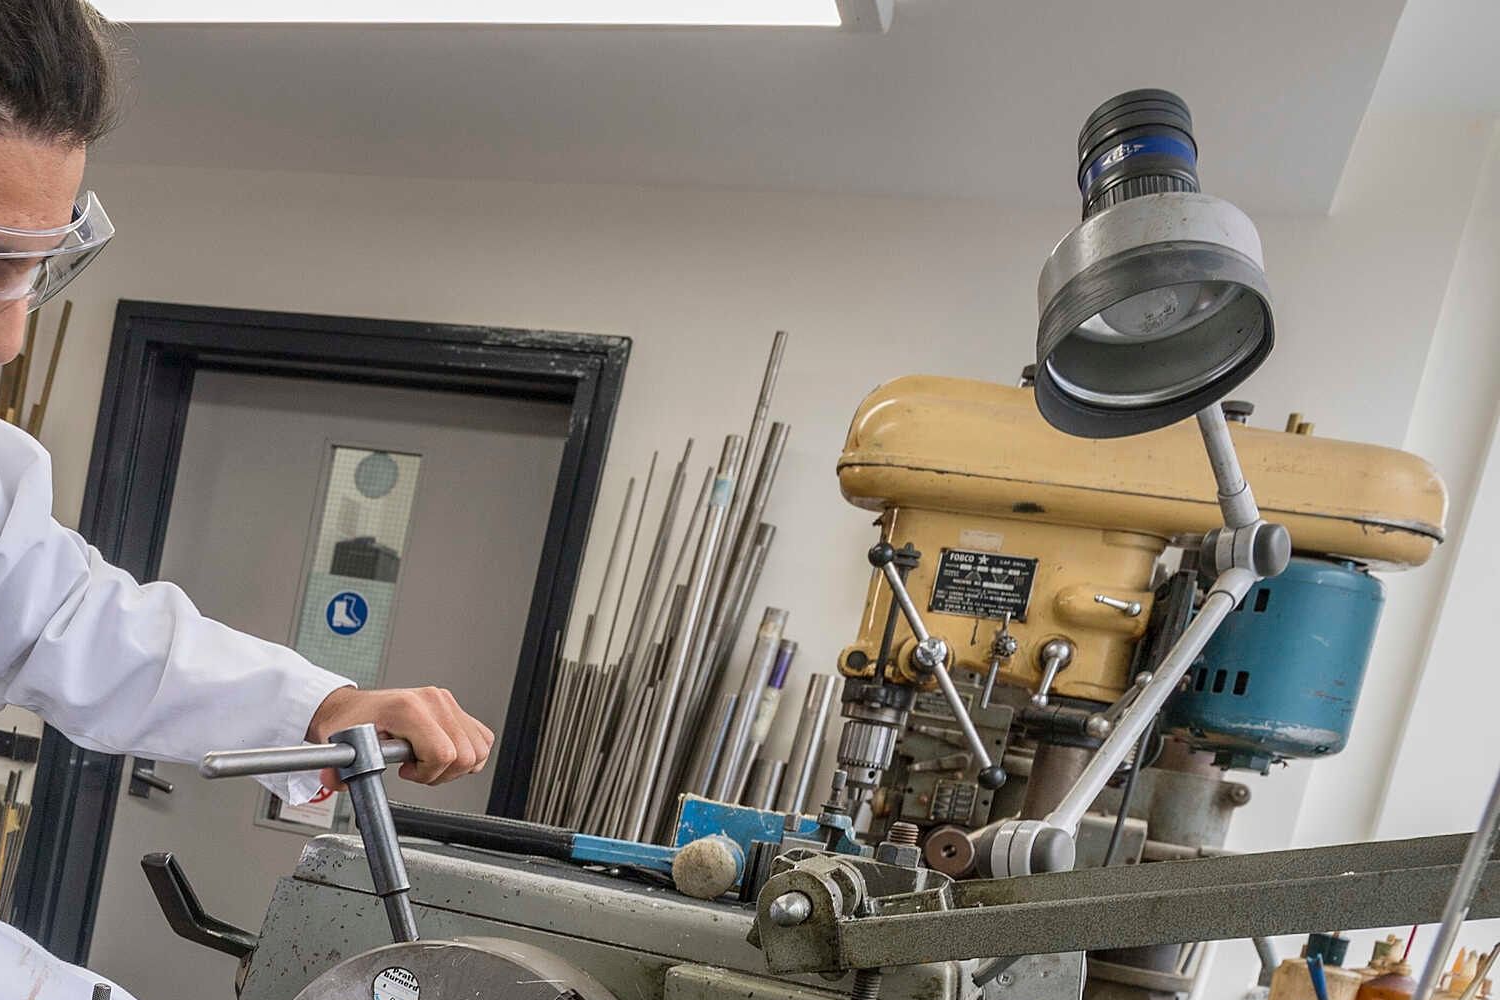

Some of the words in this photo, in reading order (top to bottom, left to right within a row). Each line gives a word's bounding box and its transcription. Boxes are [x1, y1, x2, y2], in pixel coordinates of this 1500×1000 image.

[949, 552, 975, 563] FOBCO
[383, 971, 419, 992] Burnerd
[392, 967, 416, 983] Pratt
